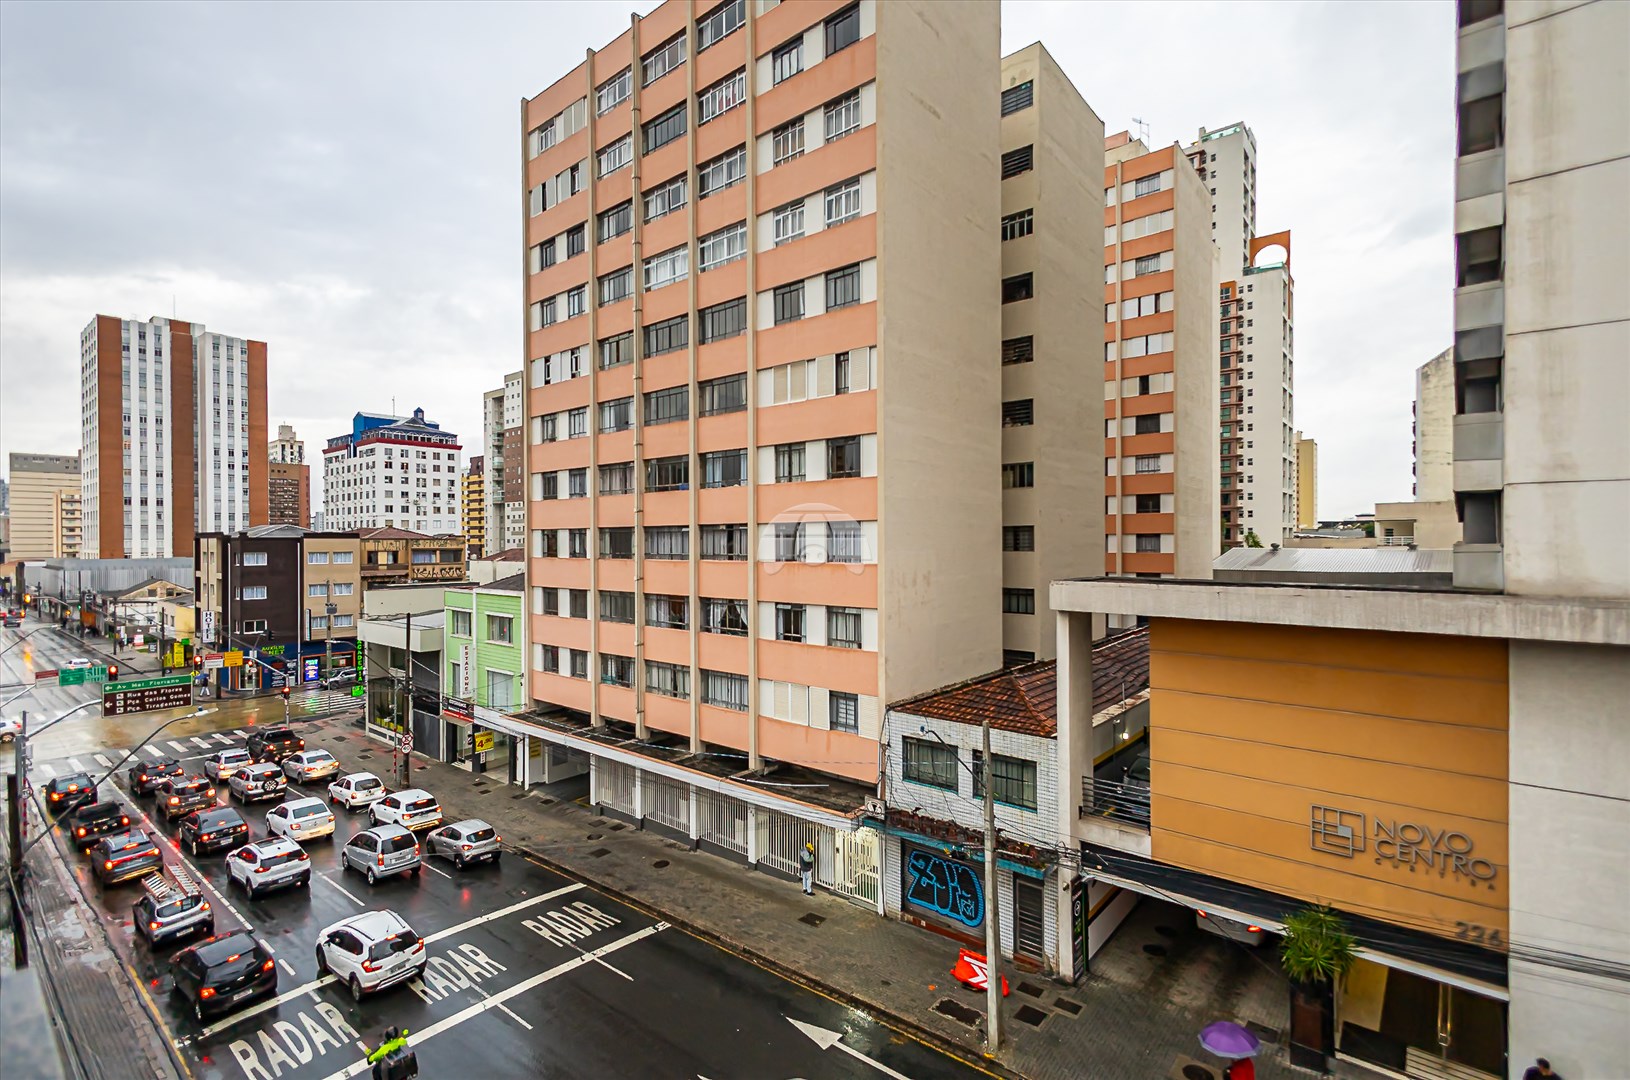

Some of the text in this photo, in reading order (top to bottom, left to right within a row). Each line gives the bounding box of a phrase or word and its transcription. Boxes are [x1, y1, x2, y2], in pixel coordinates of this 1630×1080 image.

[145, 701, 184, 710] Tiradentes
[1374, 817, 1474, 854] NOVO
[1375, 838, 1498, 880] CENTRO
[521, 901, 622, 948] RADAR
[228, 1001, 361, 1080] RADAR
